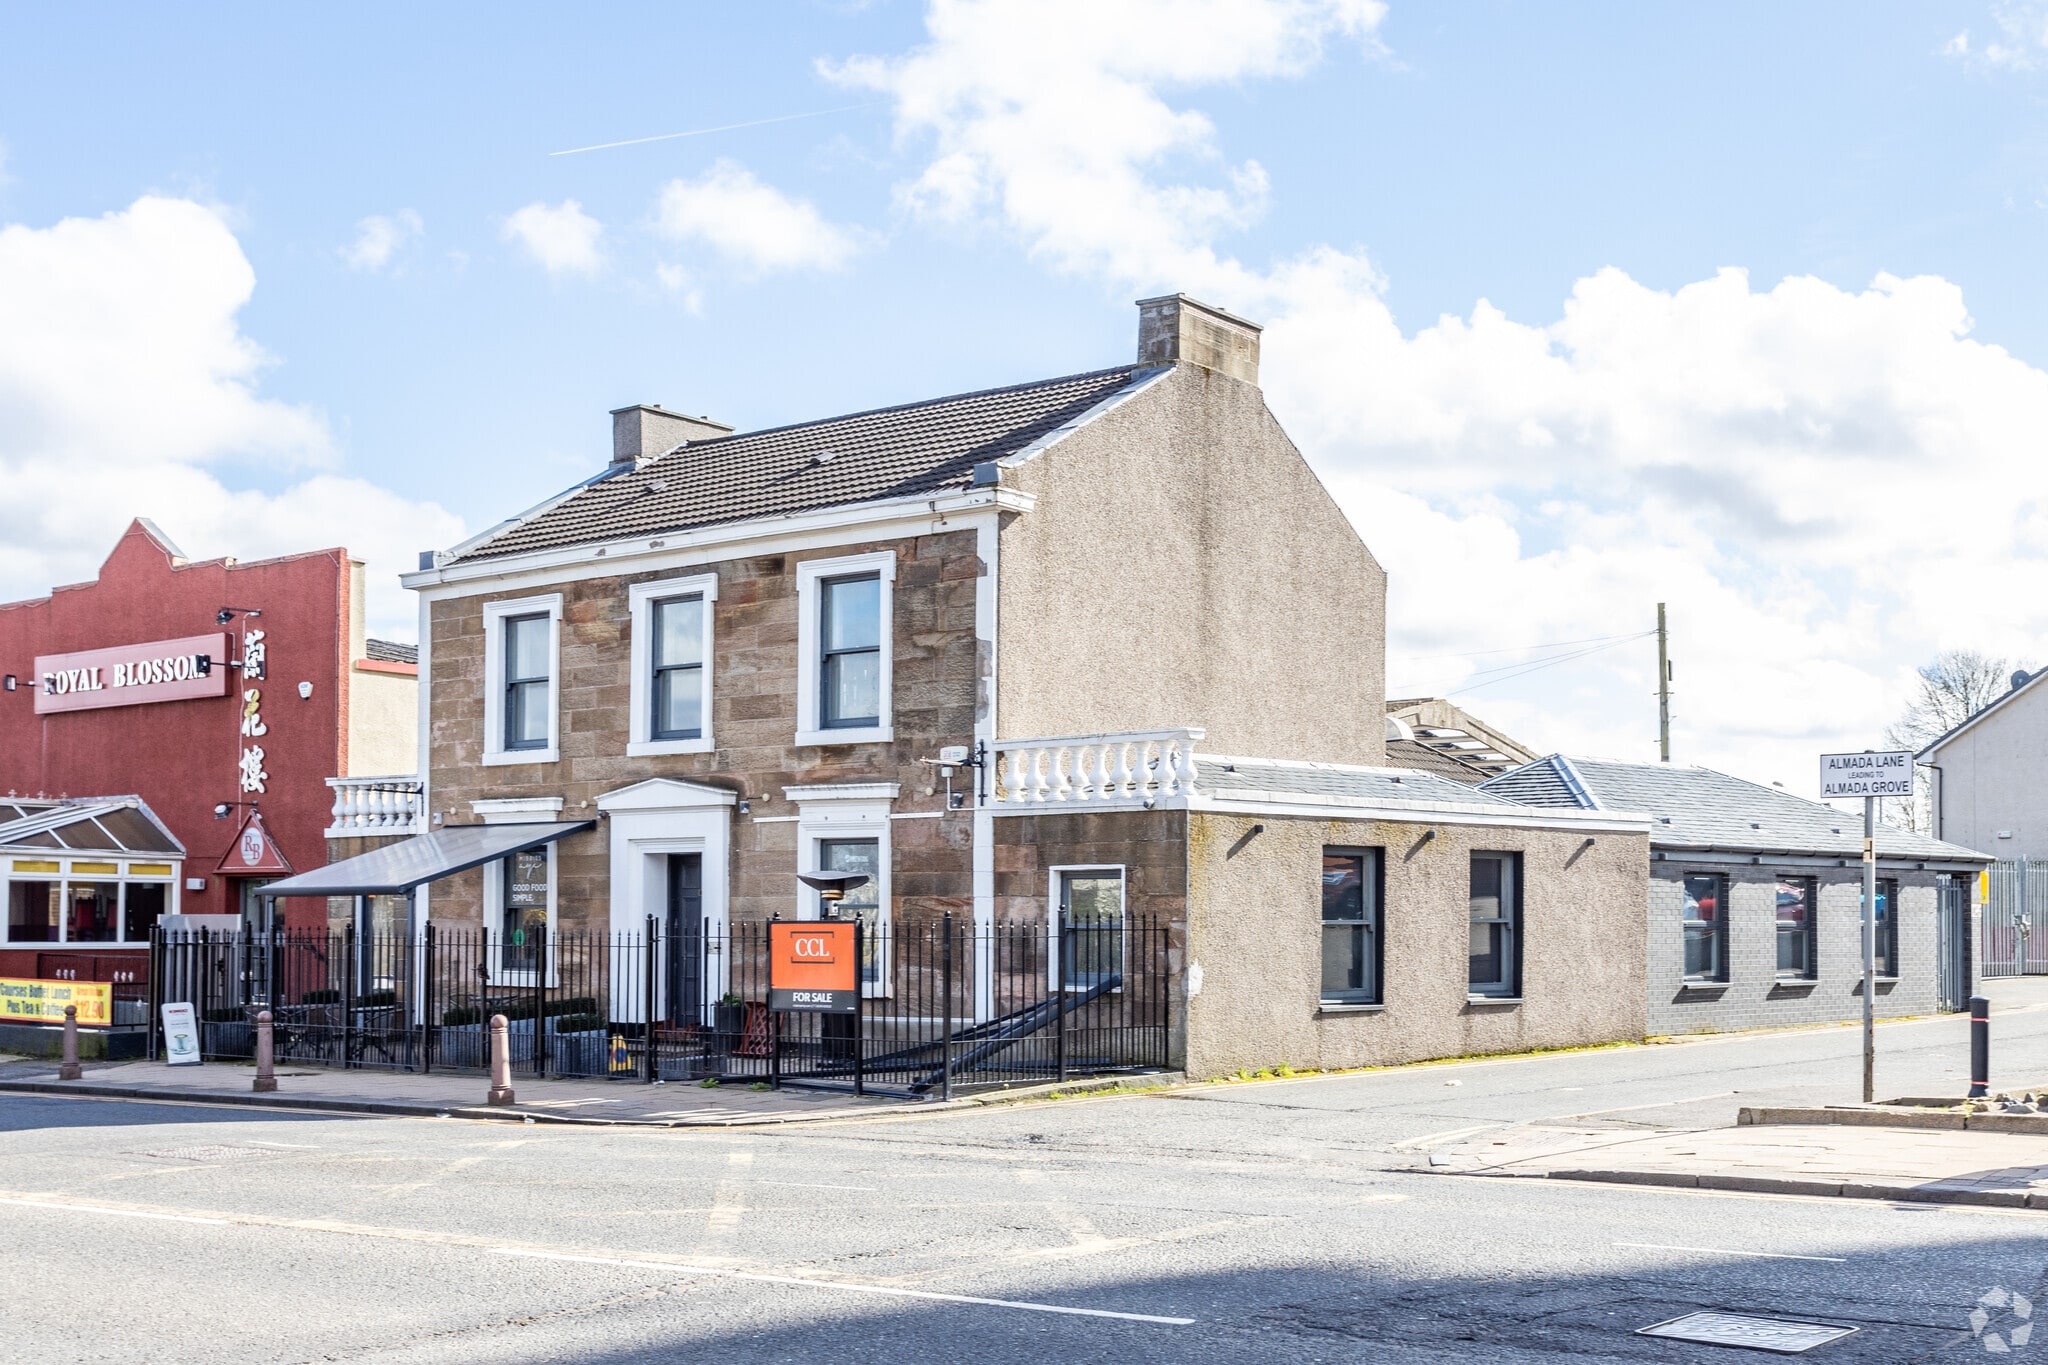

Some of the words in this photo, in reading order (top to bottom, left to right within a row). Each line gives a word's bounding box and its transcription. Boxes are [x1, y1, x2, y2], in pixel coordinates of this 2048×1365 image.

[43, 667, 102, 695] ROYAL
[1829, 757, 1873, 769] ALMADA
[1876, 755, 1904, 768] LANE
[1848, 771, 1874, 779] LEADING
[1824, 782, 1869, 794] ALMADA
[1871, 781, 1909, 793] GROVE
[512, 883, 530, 891] GOOD
[531, 883, 547, 891] FOOD
[795, 938, 830, 957] CCL
[792, 992, 810, 1002] FOR
[811, 992, 832, 1003] SALE
